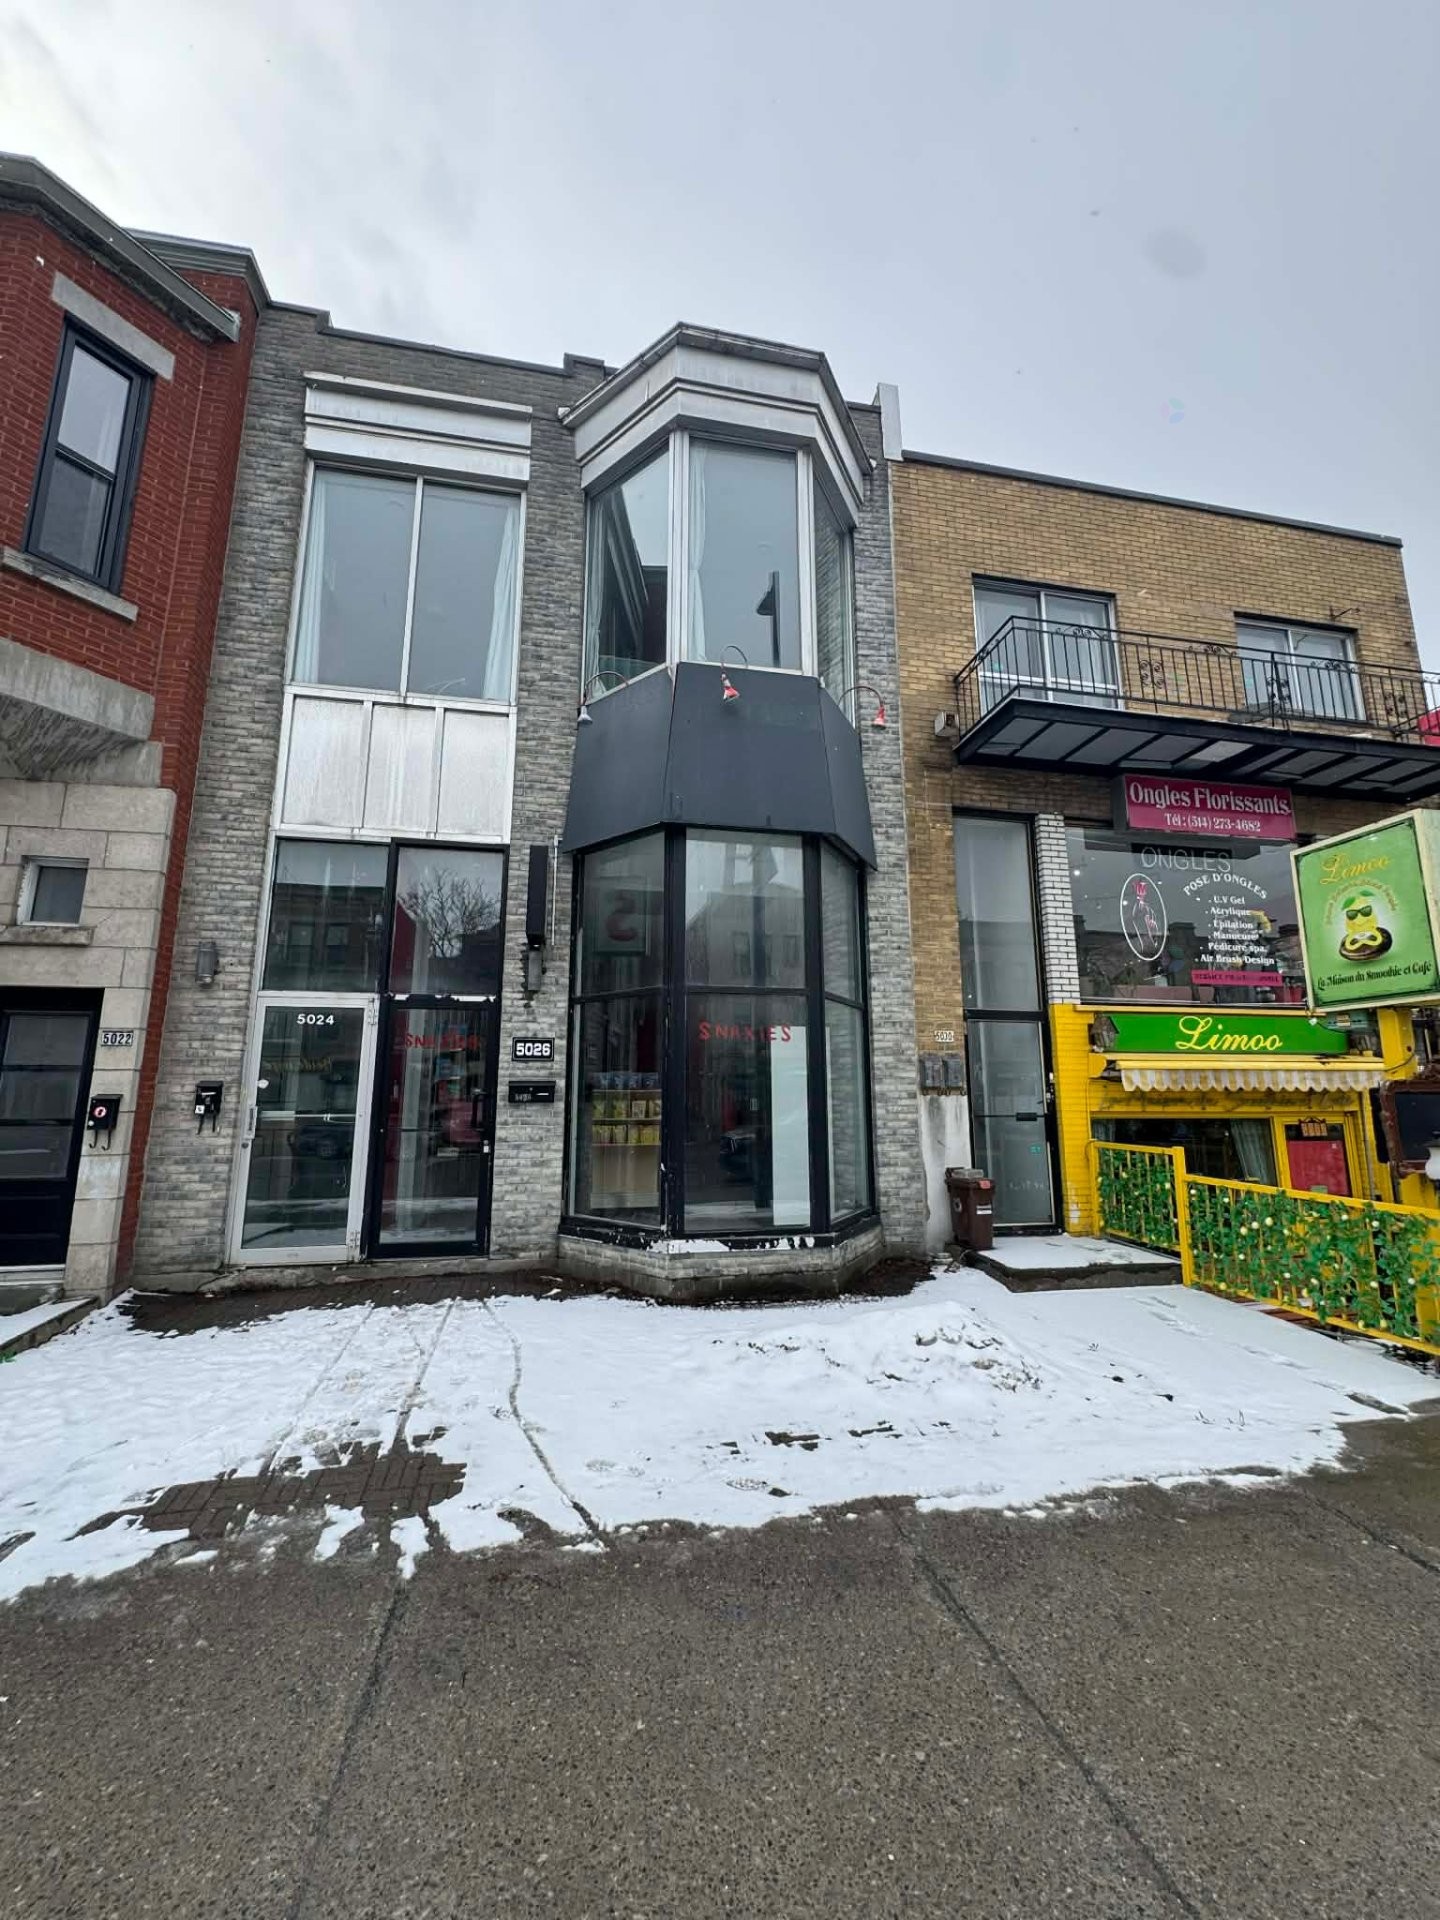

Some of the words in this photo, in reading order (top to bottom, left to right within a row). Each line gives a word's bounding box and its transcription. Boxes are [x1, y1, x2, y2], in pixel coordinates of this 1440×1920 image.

[1129, 782, 1191, 808] Ongles
[1193, 787, 1292, 815] Florissants
[1187, 814, 1212, 830] (514)
[1141, 847, 1231, 872] ONGLES
[1183, 874, 1210, 896] POSE
[1212, 873, 1267, 899] D'ONGLES
[1230, 896, 1245, 905] Gel
[1210, 907, 1250, 916] Acrylique
[1200, 954, 1214, 963] Air
[1216, 956, 1242, 964] Brush
[1244, 955, 1275, 966] Design
[296, 1013, 335, 1026] 5024
[103, 1033, 131, 1045] 5022
[1175, 1015, 1283, 1051] Limoo
[516, 1042, 551, 1056] 5026
